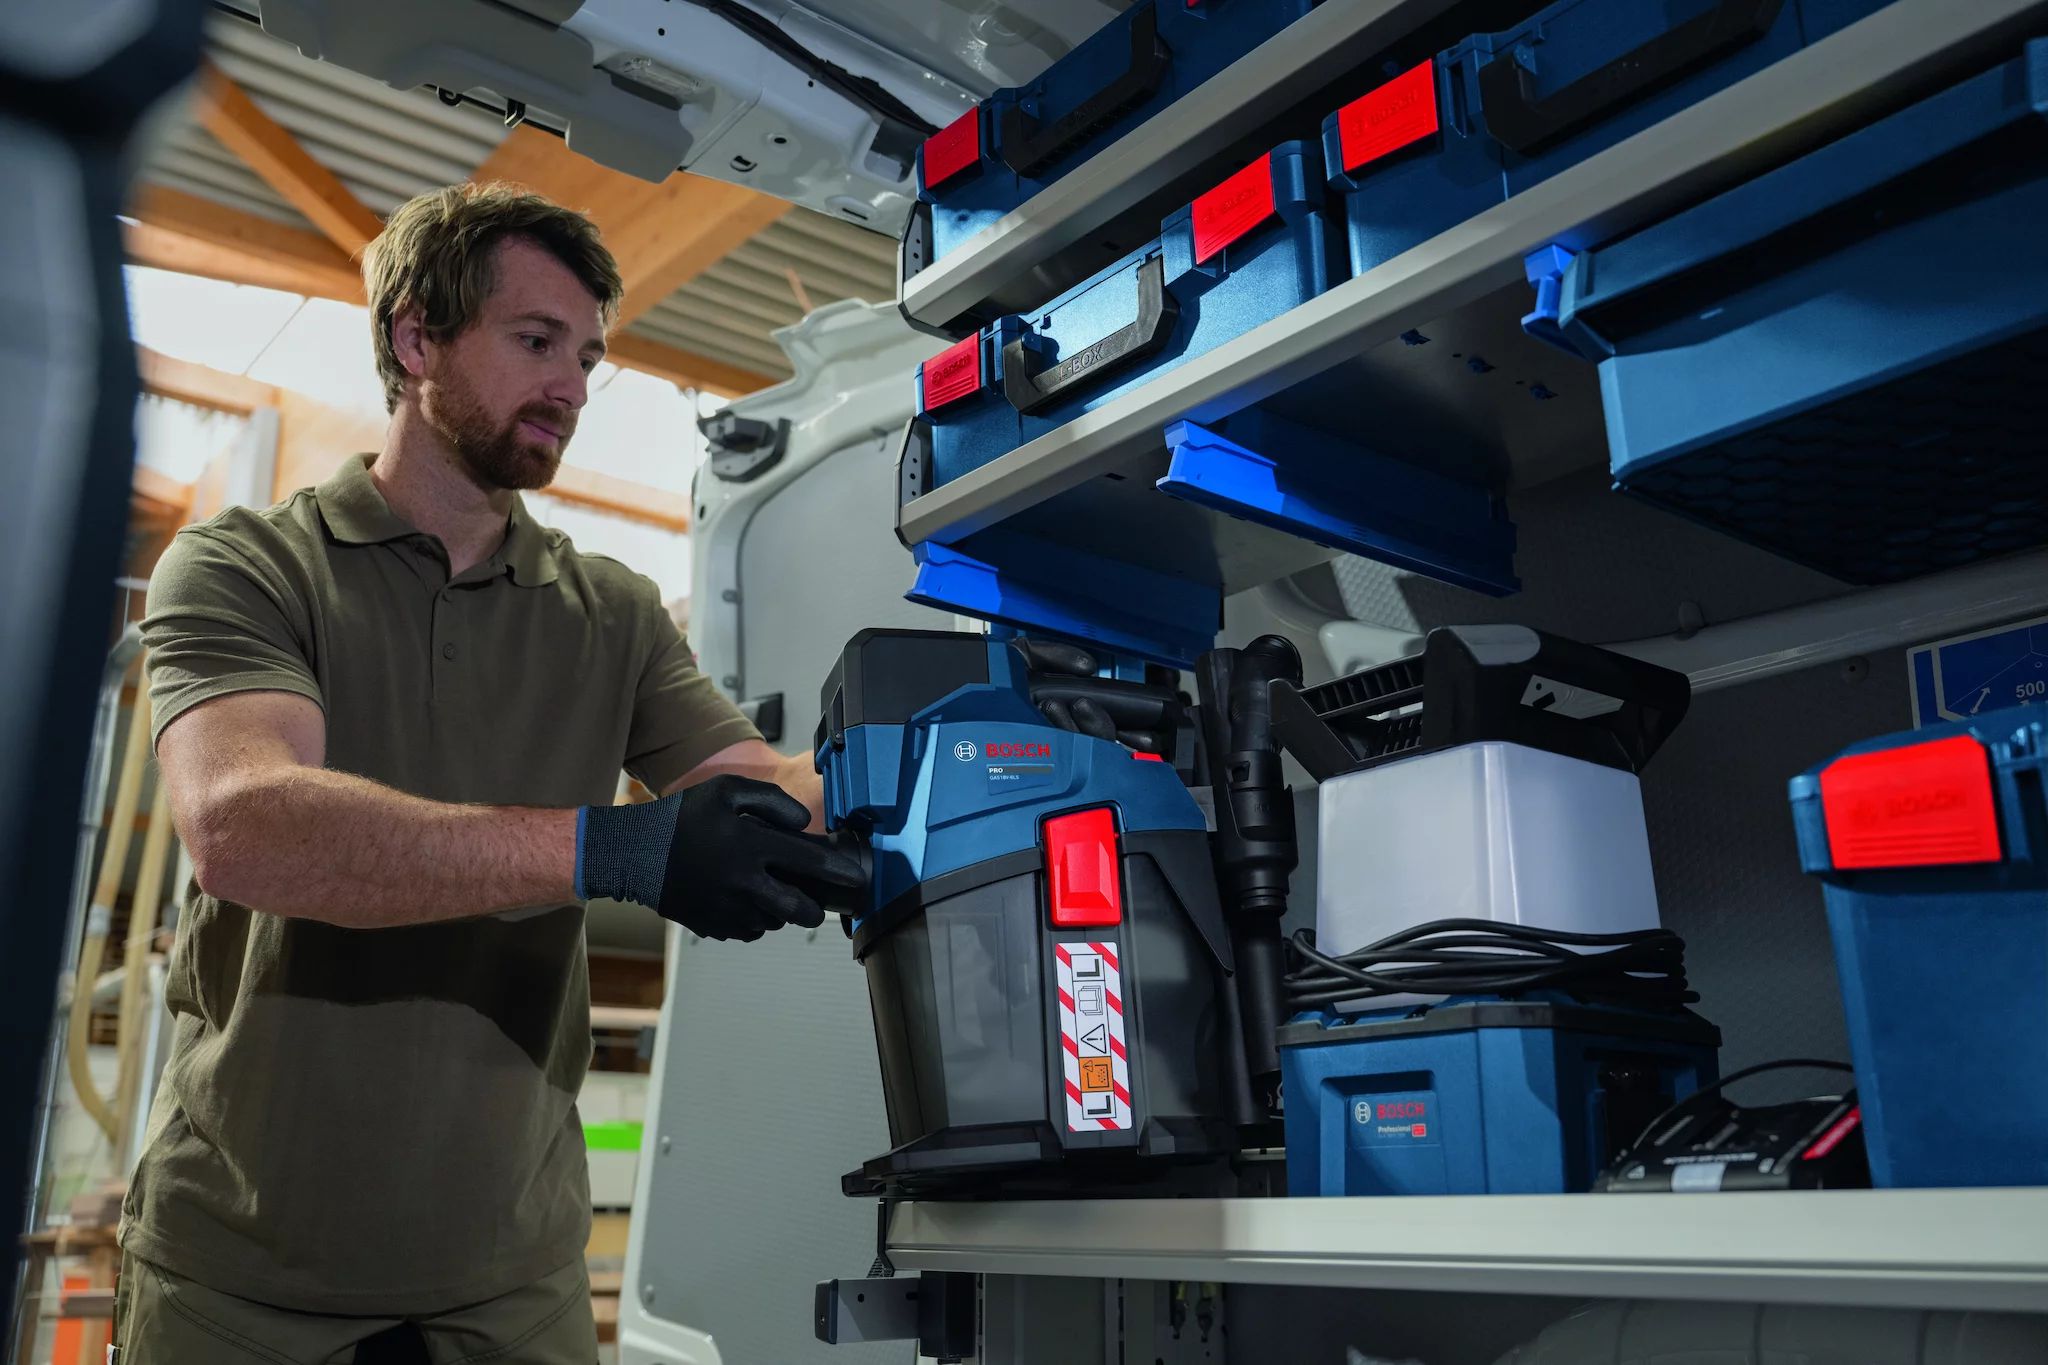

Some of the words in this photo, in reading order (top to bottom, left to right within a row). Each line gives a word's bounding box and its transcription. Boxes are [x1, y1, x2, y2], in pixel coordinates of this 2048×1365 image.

[2015, 681, 2045, 698] 500
[987, 744, 1050, 757] BOSCH
[1377, 1103, 1424, 1119] BOSCH
[1377, 1125, 1411, 1133] Professional
